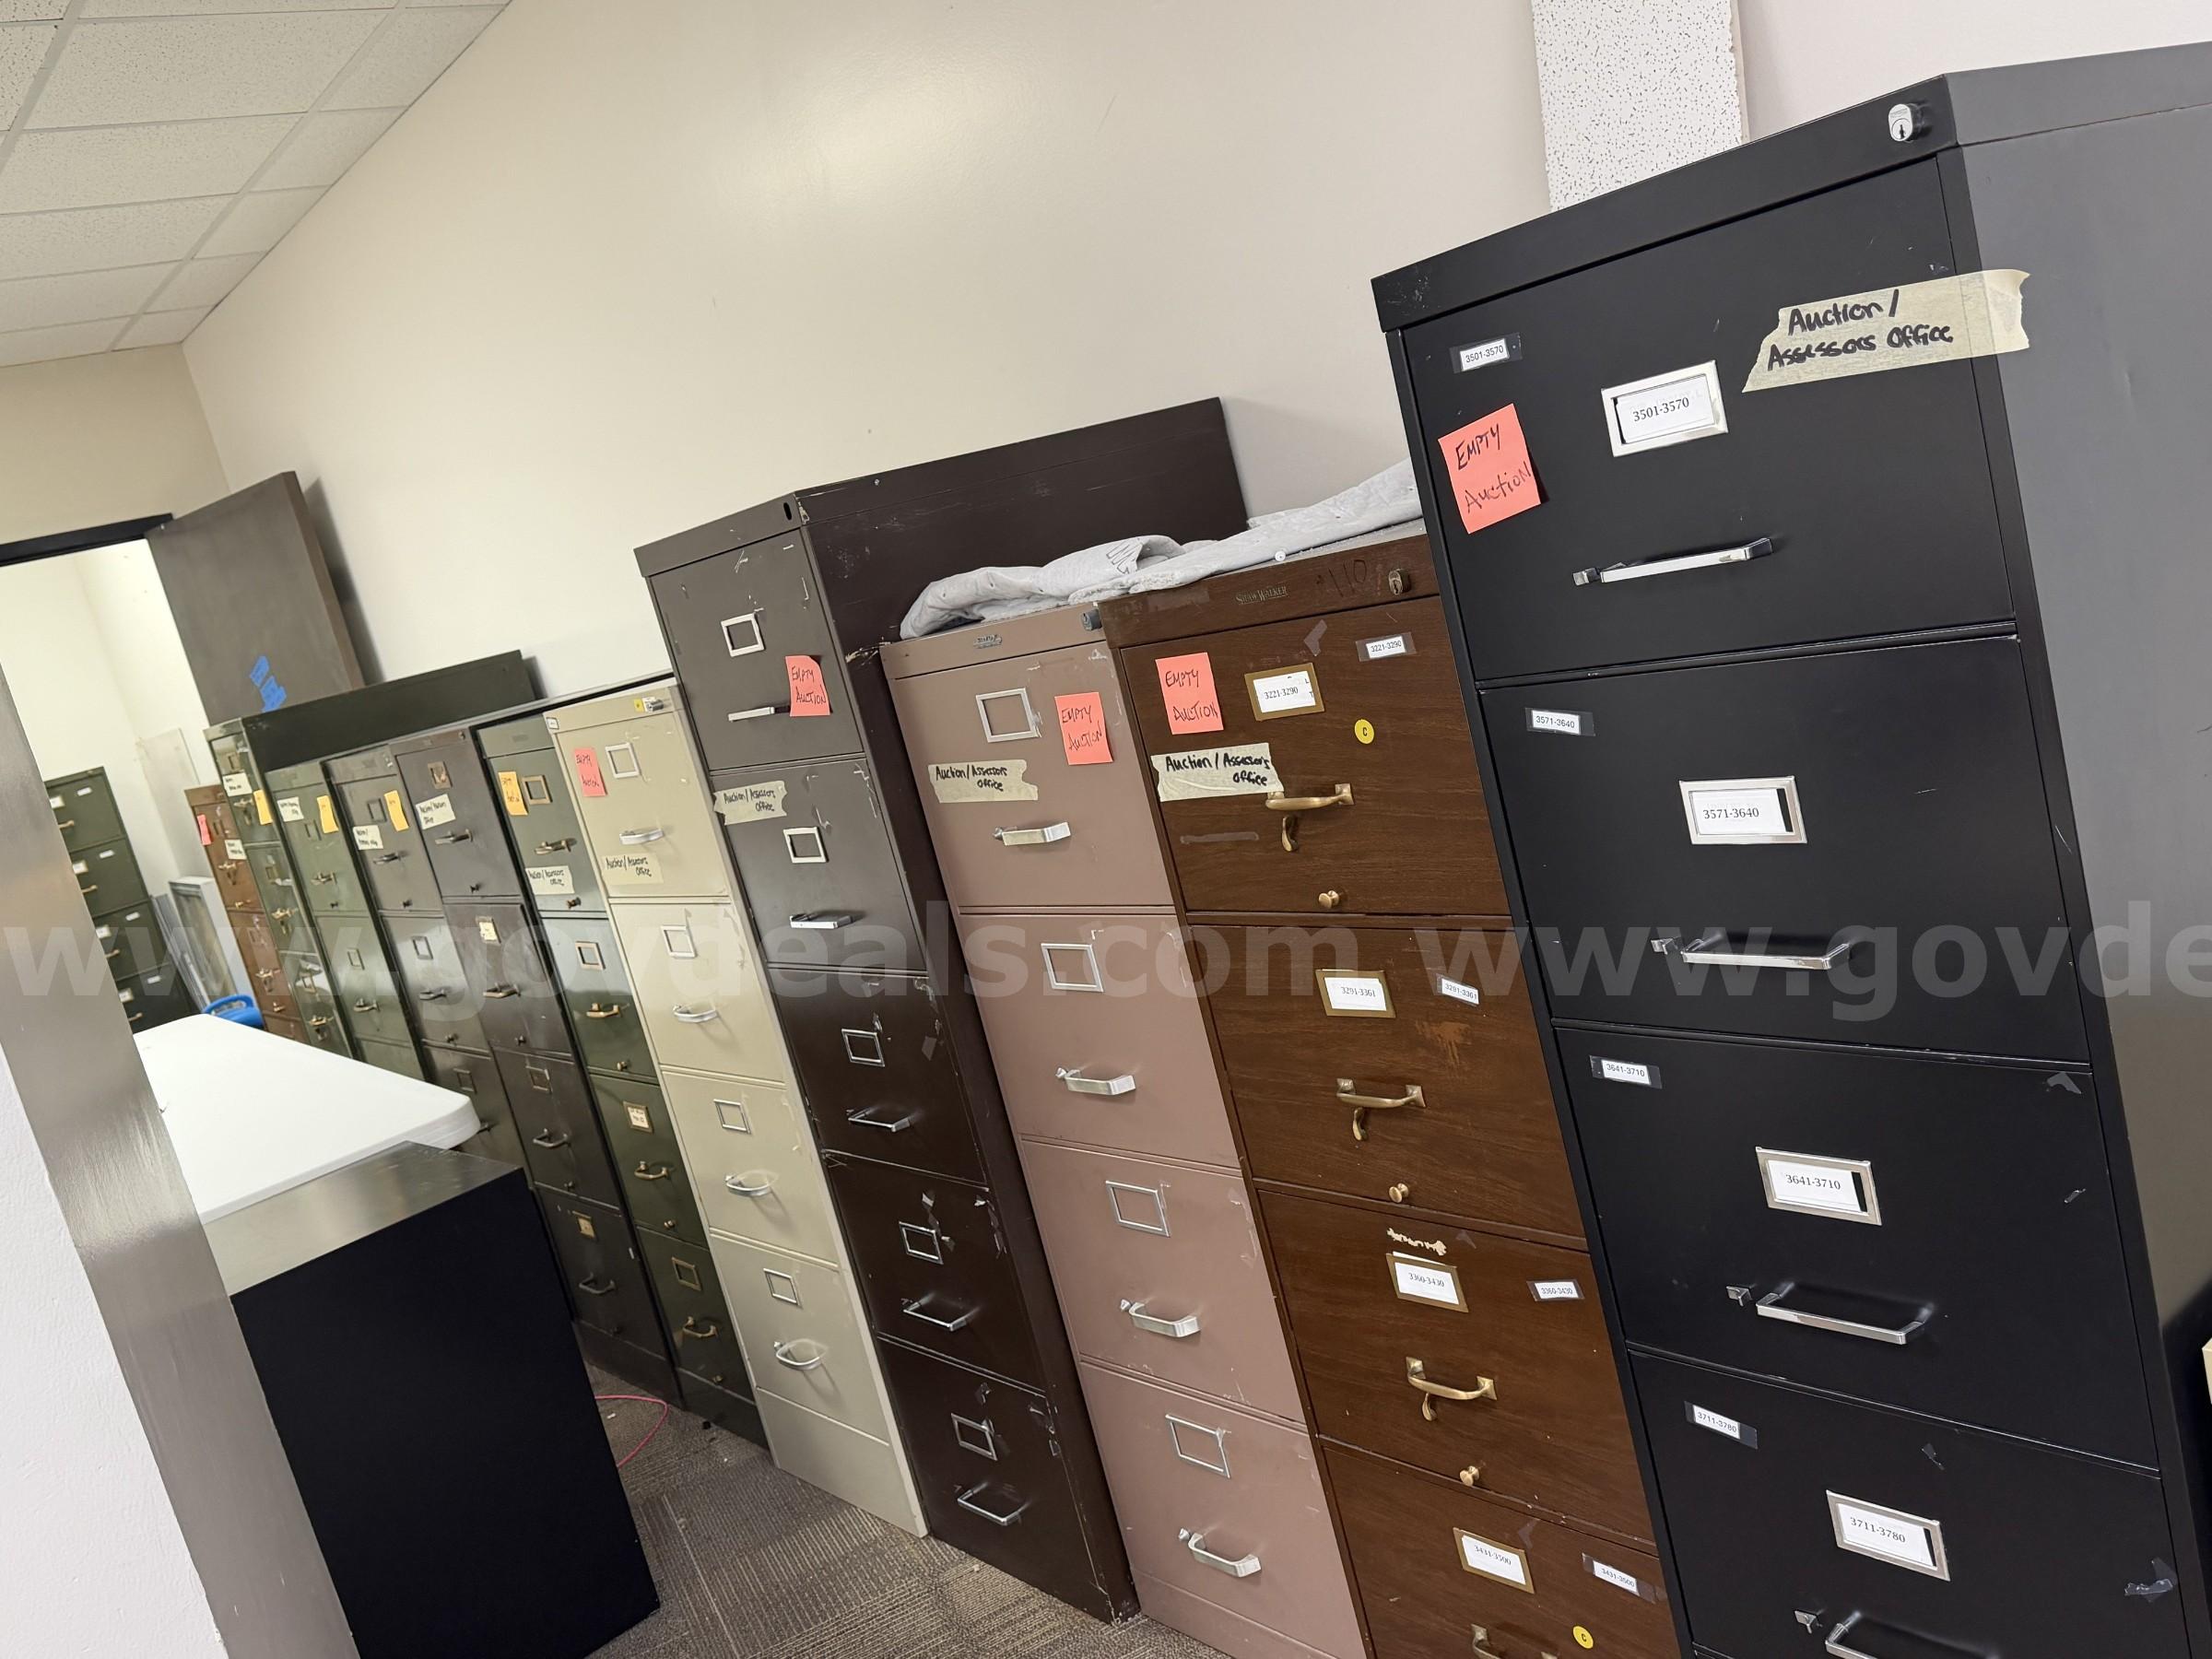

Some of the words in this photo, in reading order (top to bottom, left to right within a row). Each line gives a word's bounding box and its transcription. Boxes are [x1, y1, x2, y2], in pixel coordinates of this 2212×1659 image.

[1465, 345, 1504, 363] 3501-3570
[1767, 335, 1877, 371] Assessors
[1887, 325, 1954, 348] Office
[1632, 396, 1689, 422] 3501-3570
[1455, 423, 1500, 470] EMPTY
[1370, 641, 1402, 653] 3221-3290
[791, 665, 815, 683] EMPTY
[1165, 668, 1199, 688] EMPTY
[1264, 687, 1299, 700] 3221-3290
[1061, 704, 1092, 724] EMPTY
[1172, 700, 1218, 722] AUCTION
[1535, 715, 1575, 729] 3571-3640
[1067, 720, 1102, 751] AUCTION
[1702, 806, 1759, 819] 3571-3640
[1341, 986, 1377, 997] 3291-3361
[1606, 1063, 1645, 1077] 3641-3710
[1785, 1174, 1841, 1191] 3641-3710
[1698, 1411, 1737, 1433] 3711-3780
[1850, 1517, 1906, 1544] 3711-3780
[1475, 1545, 1512, 1565] 3431-3500
[1601, 1568, 1635, 1588] 3431-3500
